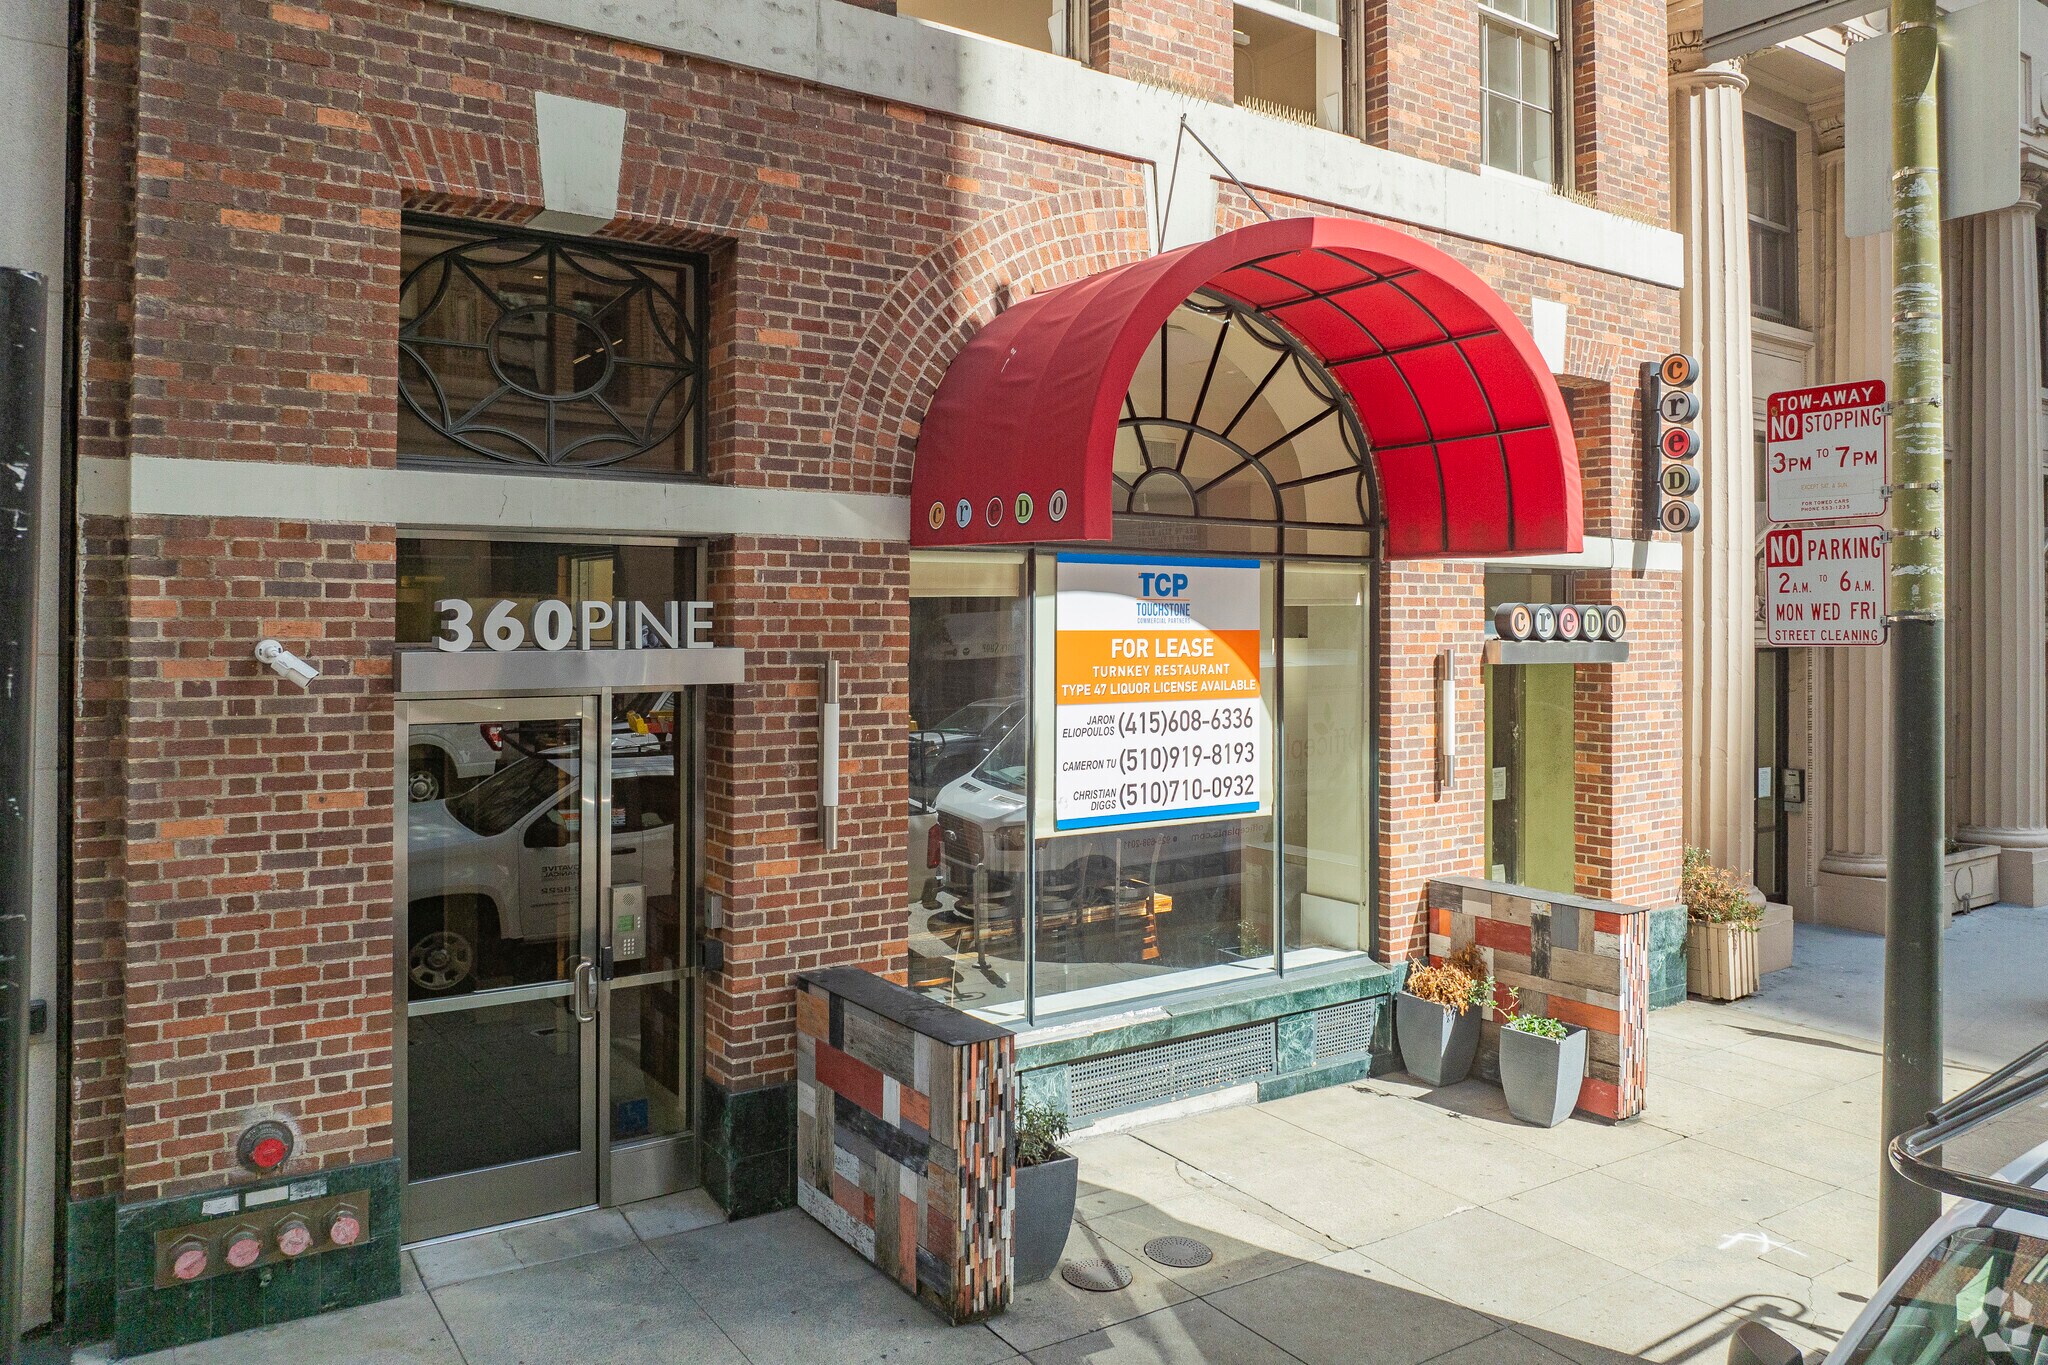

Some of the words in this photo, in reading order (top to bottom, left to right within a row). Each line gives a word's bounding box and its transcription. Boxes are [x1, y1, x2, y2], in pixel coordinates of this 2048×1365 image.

[1777, 386, 1874, 412] TOW-AWAY
[1771, 414, 1799, 440] NO
[1805, 407, 1881, 433] STOPPING
[1816, 449, 1829, 458] TO
[1770, 535, 1799, 564] NO
[1807, 536, 1881, 561] PARKING
[1138, 572, 1189, 597] TCP
[1137, 603, 1190, 617] TOUCHSTONE
[1776, 603, 1803, 621] MON
[1811, 602, 1841, 621] WED
[1851, 602, 1876, 620] FRI
[1775, 630, 1815, 641] STREET
[1821, 630, 1878, 641] CLEANING
[1111, 638, 1148, 658] FOR
[1155, 637, 1214, 658] LEASE
[1093, 665, 1150, 678] TURNKEY
[1154, 664, 1230, 676] RESTAURANT
[1062, 684, 1091, 696] TYPE
[1094, 683, 1107, 695] 47
[1110, 682, 1150, 695] LIQUOR
[1153, 682, 1198, 693] LICENSE
[1201, 679, 1256, 692] AVAILABLE
[1087, 715, 1115, 725] JARON
[1118, 707, 1253, 738] (415)608-6336
[1062, 726, 1115, 738] ELIOPOULOS
[1062, 760, 1104, 772] CAMERON
[1106, 759, 1116, 768] TU
[1120, 742, 1254, 775] (510)919-8193
[1073, 788, 1116, 801] CHRISTIAN
[1120, 775, 1254, 810] (510)710-0932
[1091, 801, 1116, 811] DIGGS
